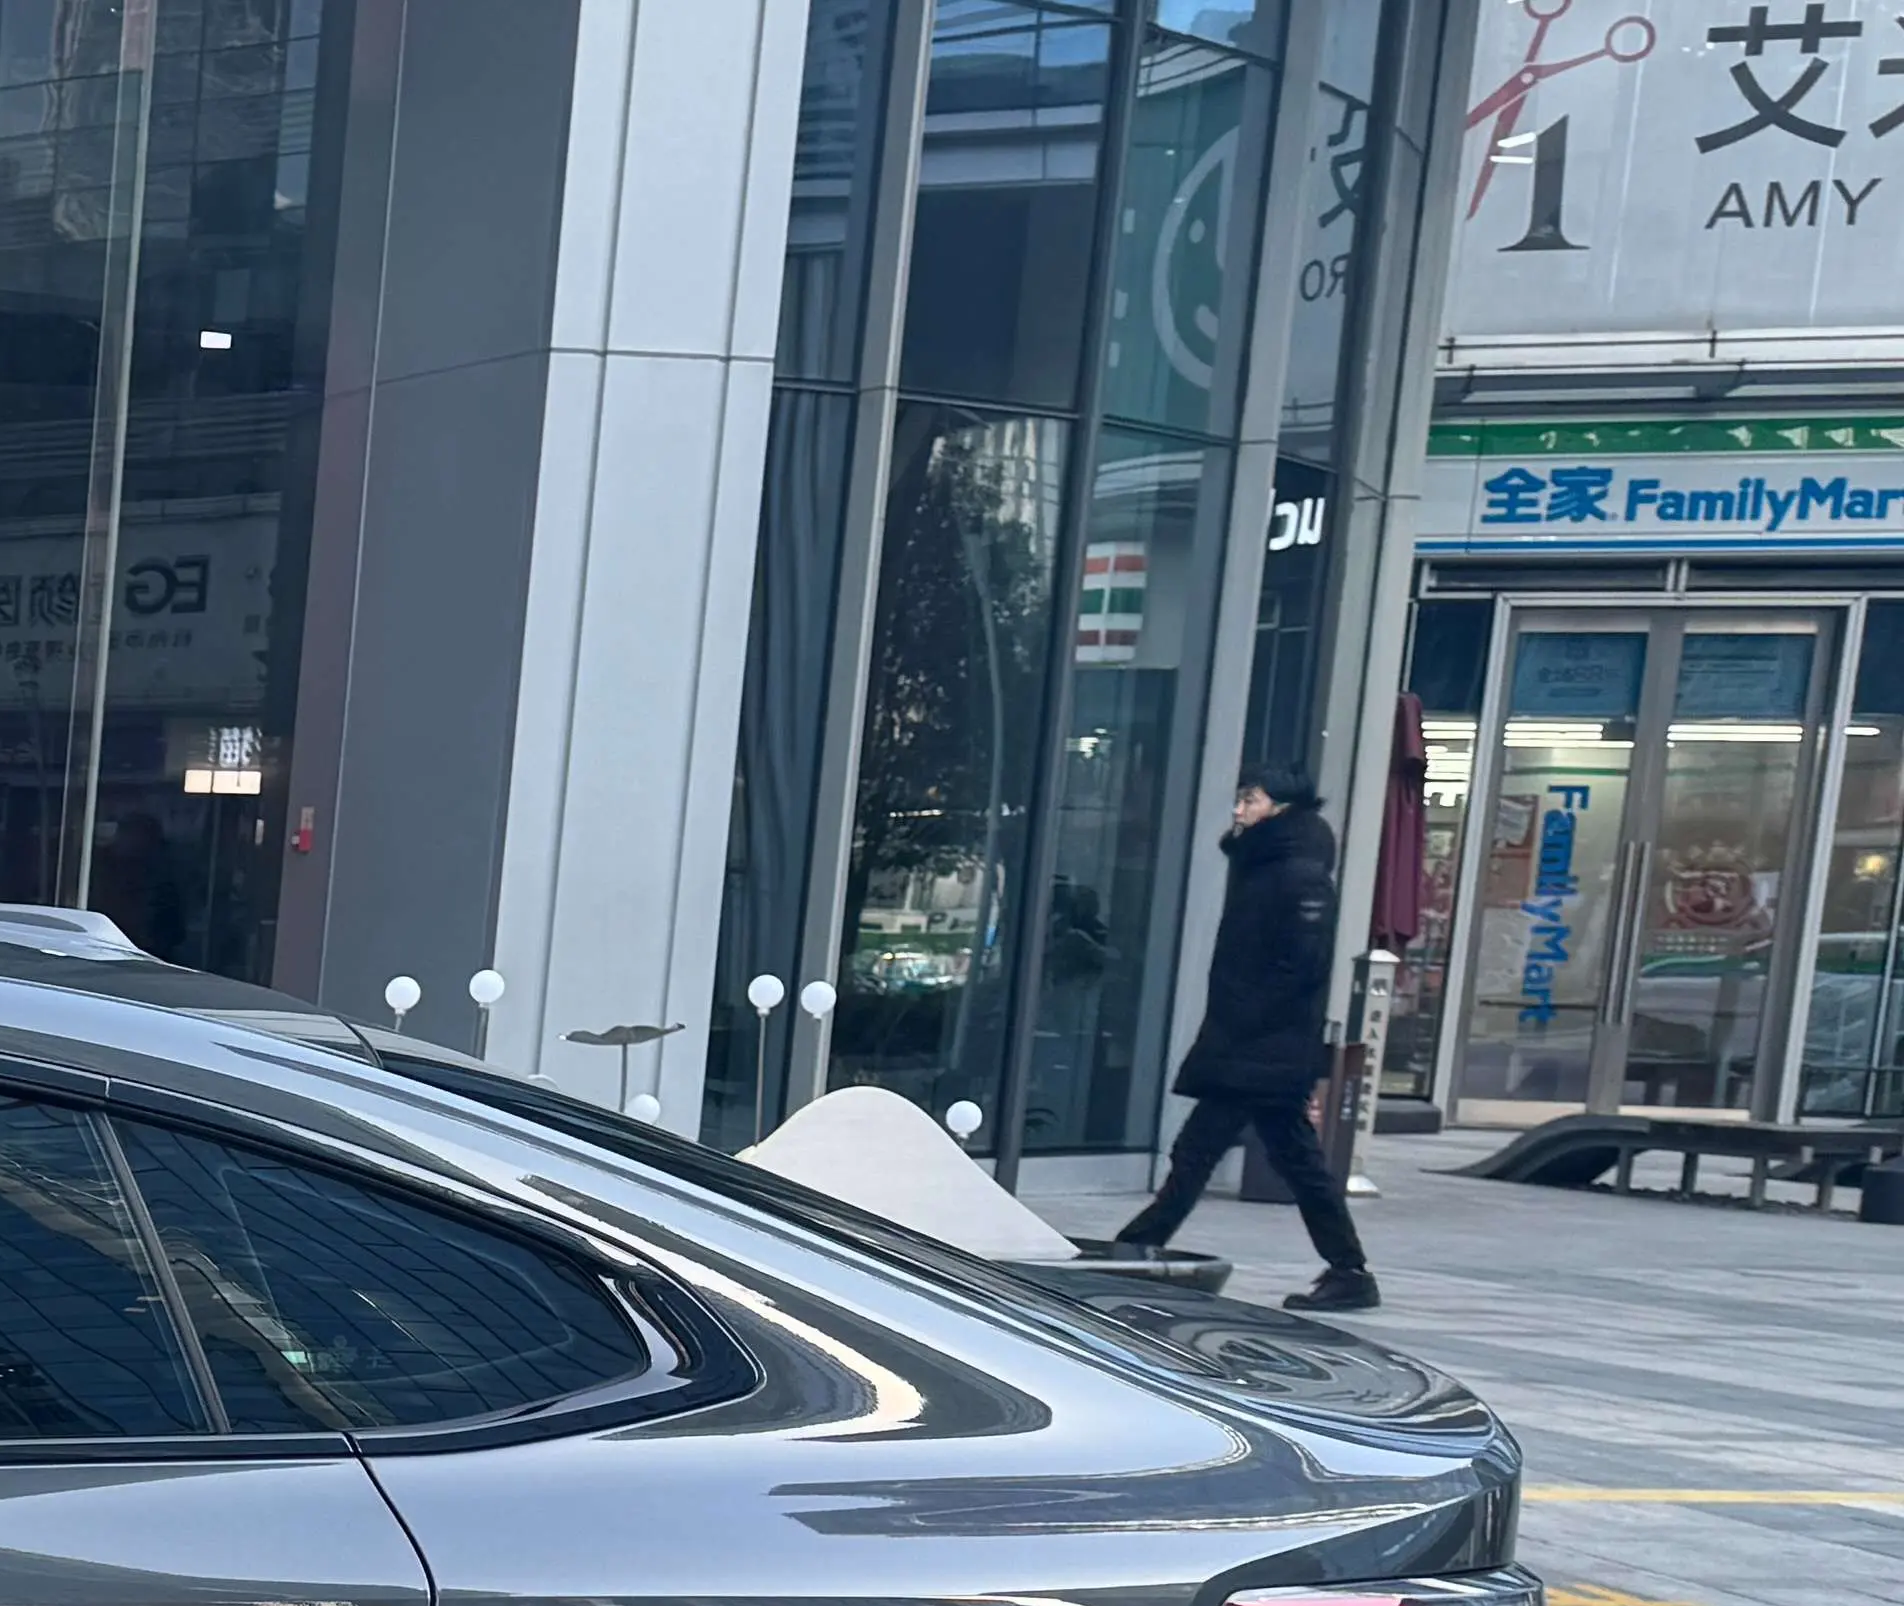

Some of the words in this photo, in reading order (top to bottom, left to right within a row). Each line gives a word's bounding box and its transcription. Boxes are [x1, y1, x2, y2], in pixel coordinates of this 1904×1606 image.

[1704, 178, 1883, 230] AMY
[1480, 465, 1614, 524] 全家
[1624, 476, 1904, 532] FamilyMar
[1517, 784, 1591, 1023] FamilyMart
